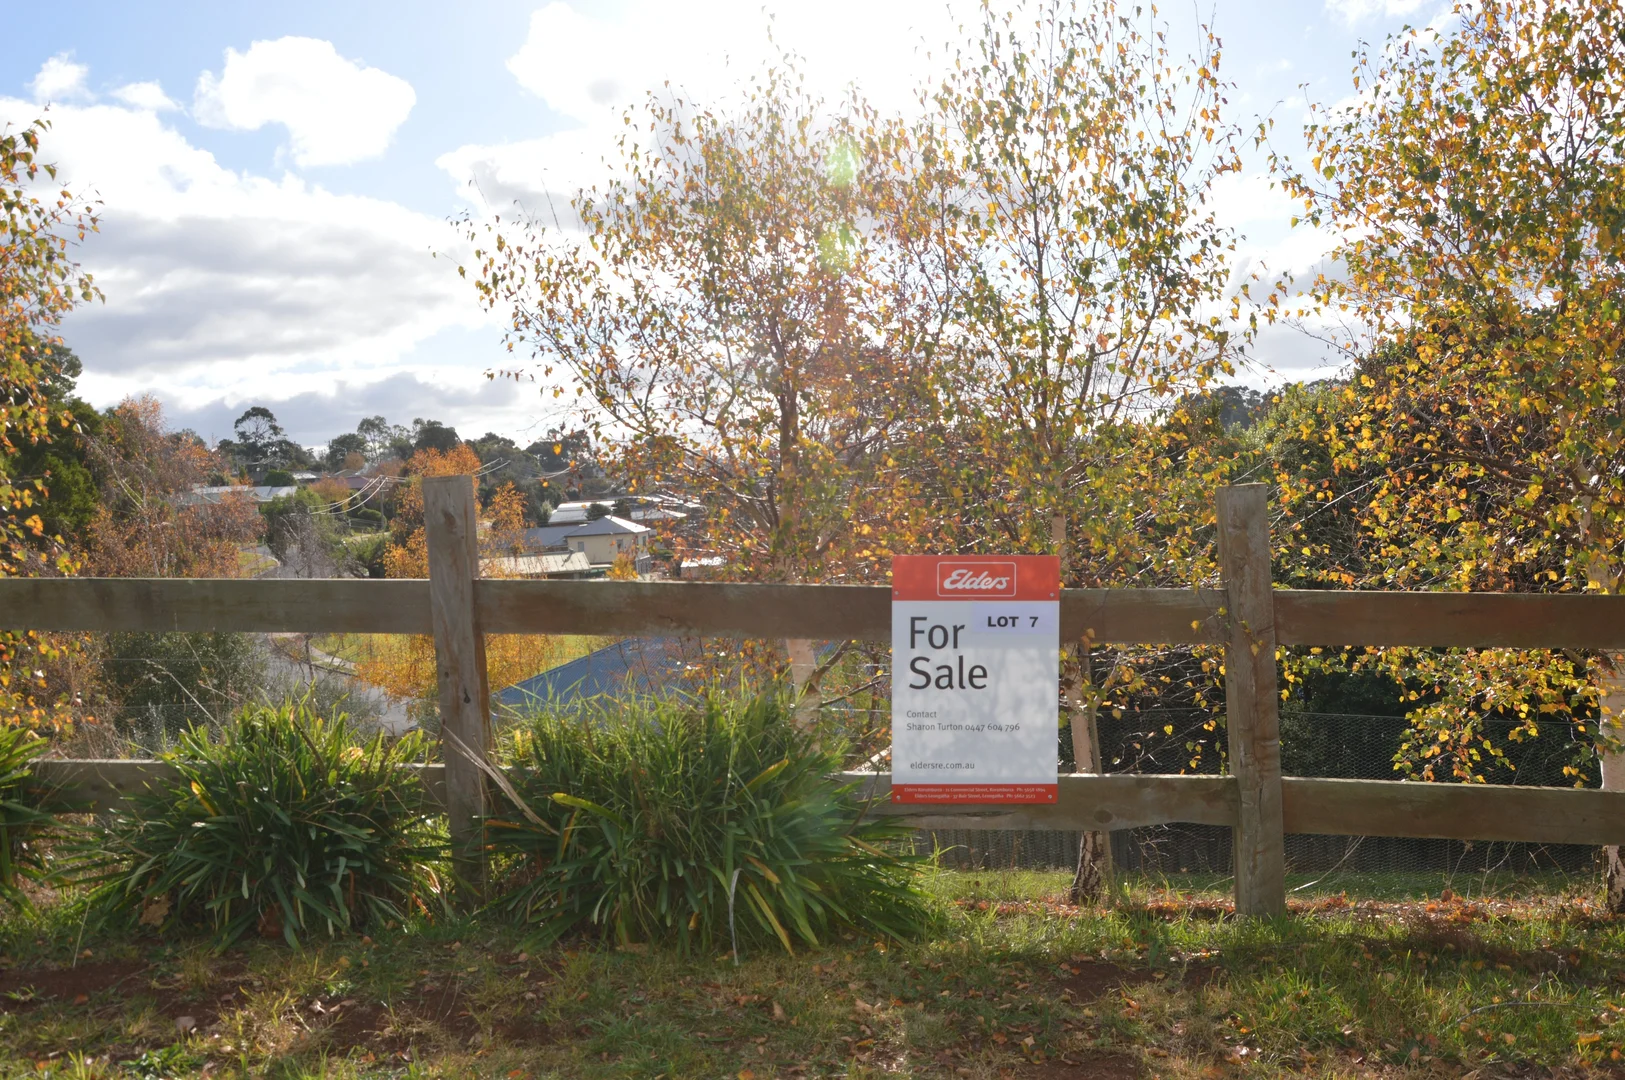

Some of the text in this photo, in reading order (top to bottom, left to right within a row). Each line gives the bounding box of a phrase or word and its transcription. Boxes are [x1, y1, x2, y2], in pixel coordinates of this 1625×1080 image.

[943, 569, 1010, 590] Elders
[987, 616, 1039, 628] LOT 7
[910, 616, 965, 649] For
[909, 655, 988, 690] Sale
[906, 710, 937, 718] Contact
[906, 723, 1020, 732] Sharon Turton 0447 604 796
